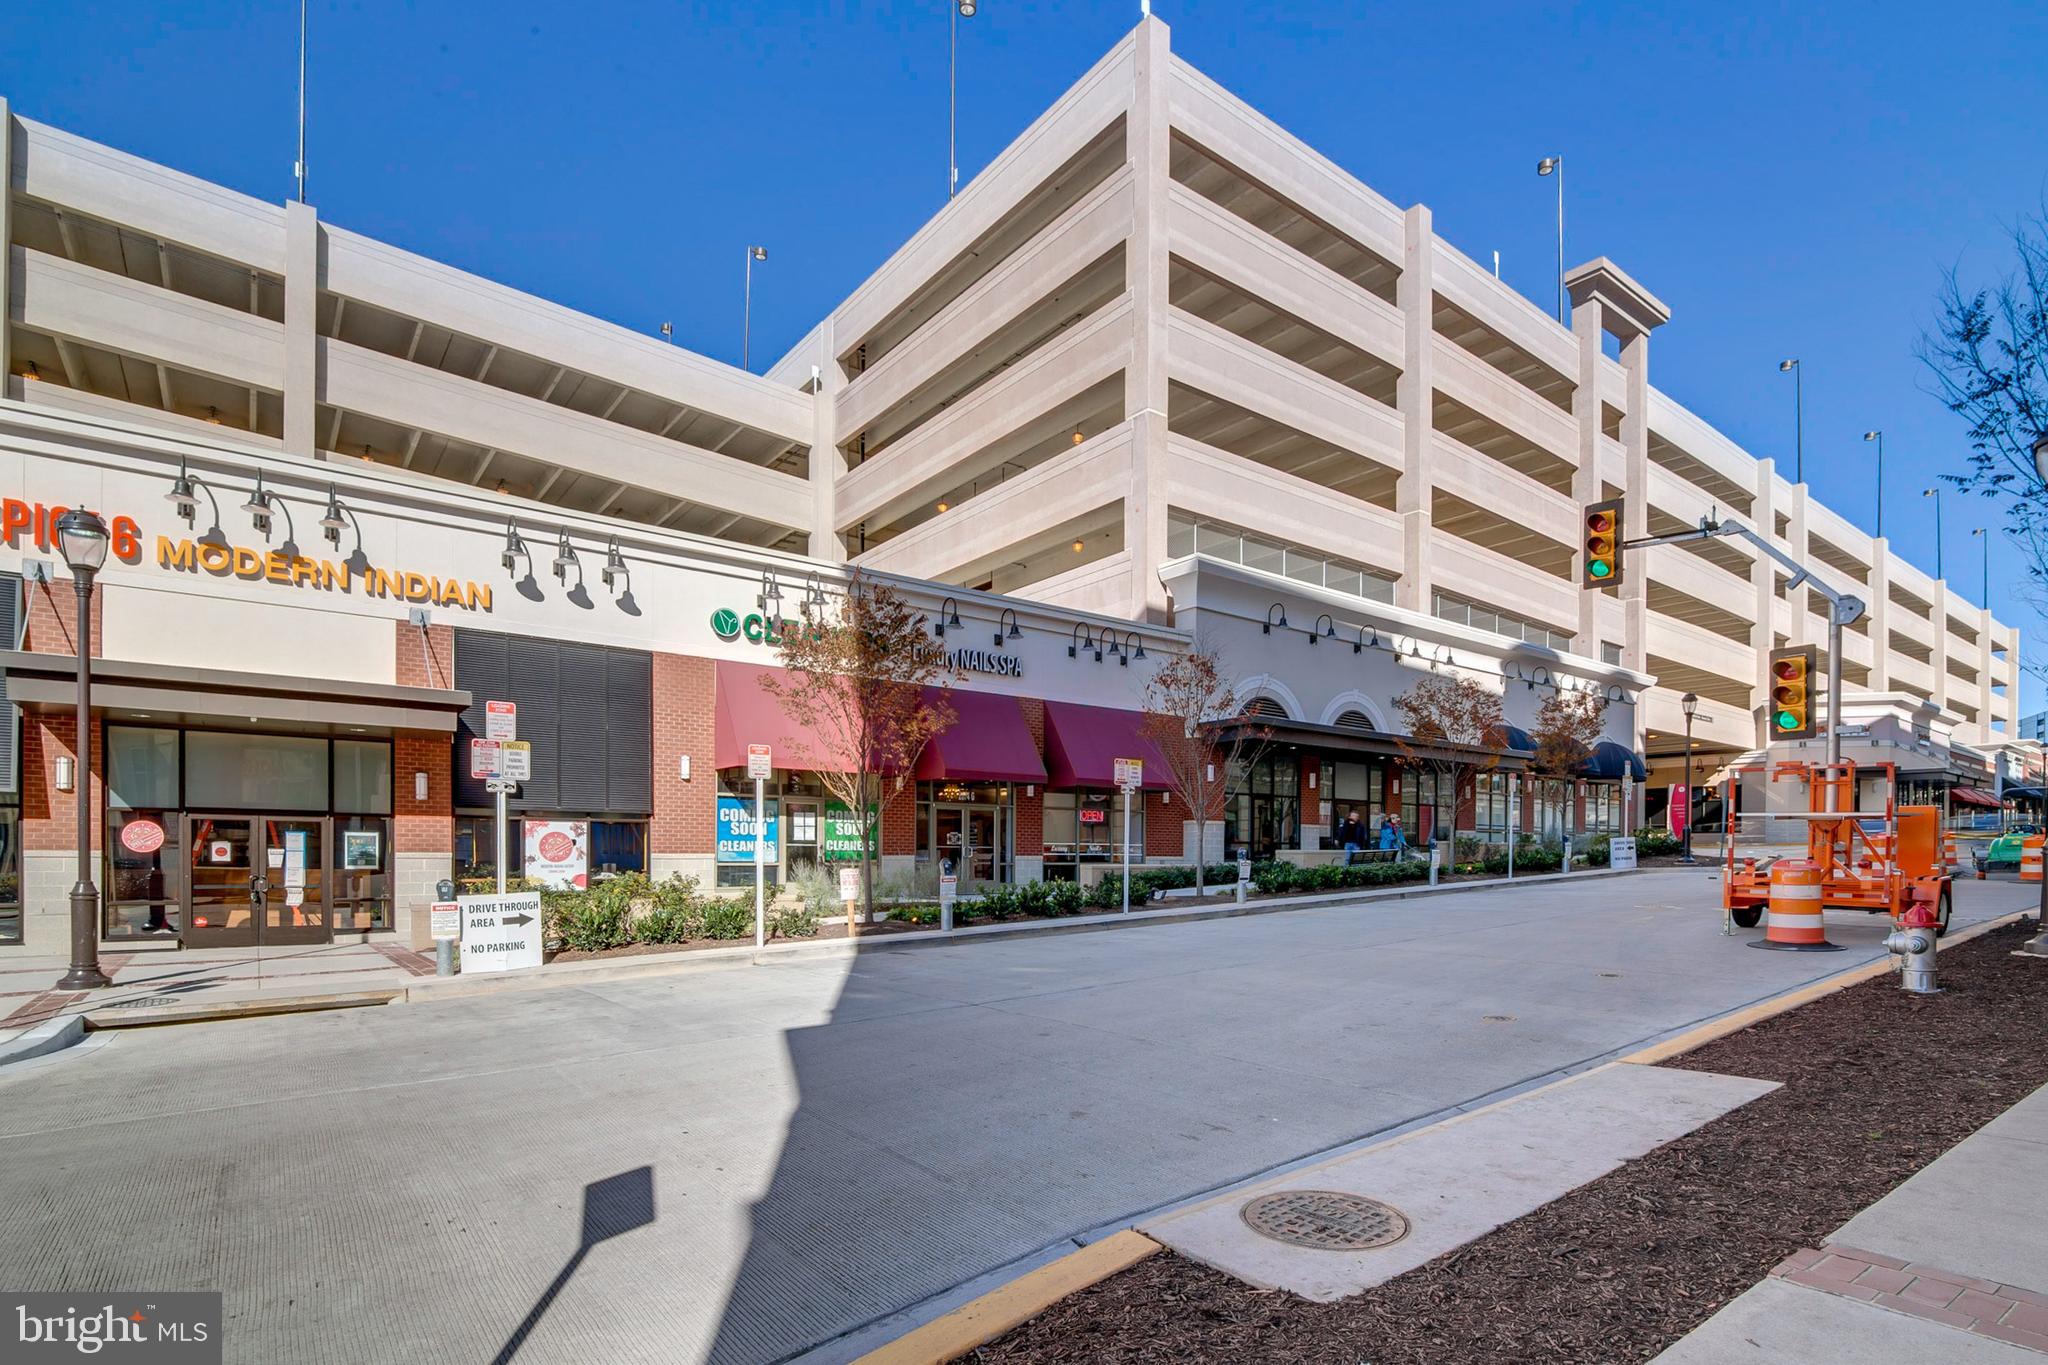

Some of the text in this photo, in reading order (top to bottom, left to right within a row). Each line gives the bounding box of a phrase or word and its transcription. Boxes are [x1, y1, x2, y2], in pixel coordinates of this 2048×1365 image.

[3, 498, 491, 609] PIC 6 MODERN INDIAN
[959, 649, 998, 674] NAILS
[998, 655, 1023, 677] SPA
[1081, 811, 1103, 820] OPEN
[836, 823, 866, 836] SOO
[826, 840, 875, 851] CLEANES
[468, 901, 539, 914] DRIVE THROUGH
[470, 918, 495, 928] AREA
[471, 941, 526, 954] NO PARKING
